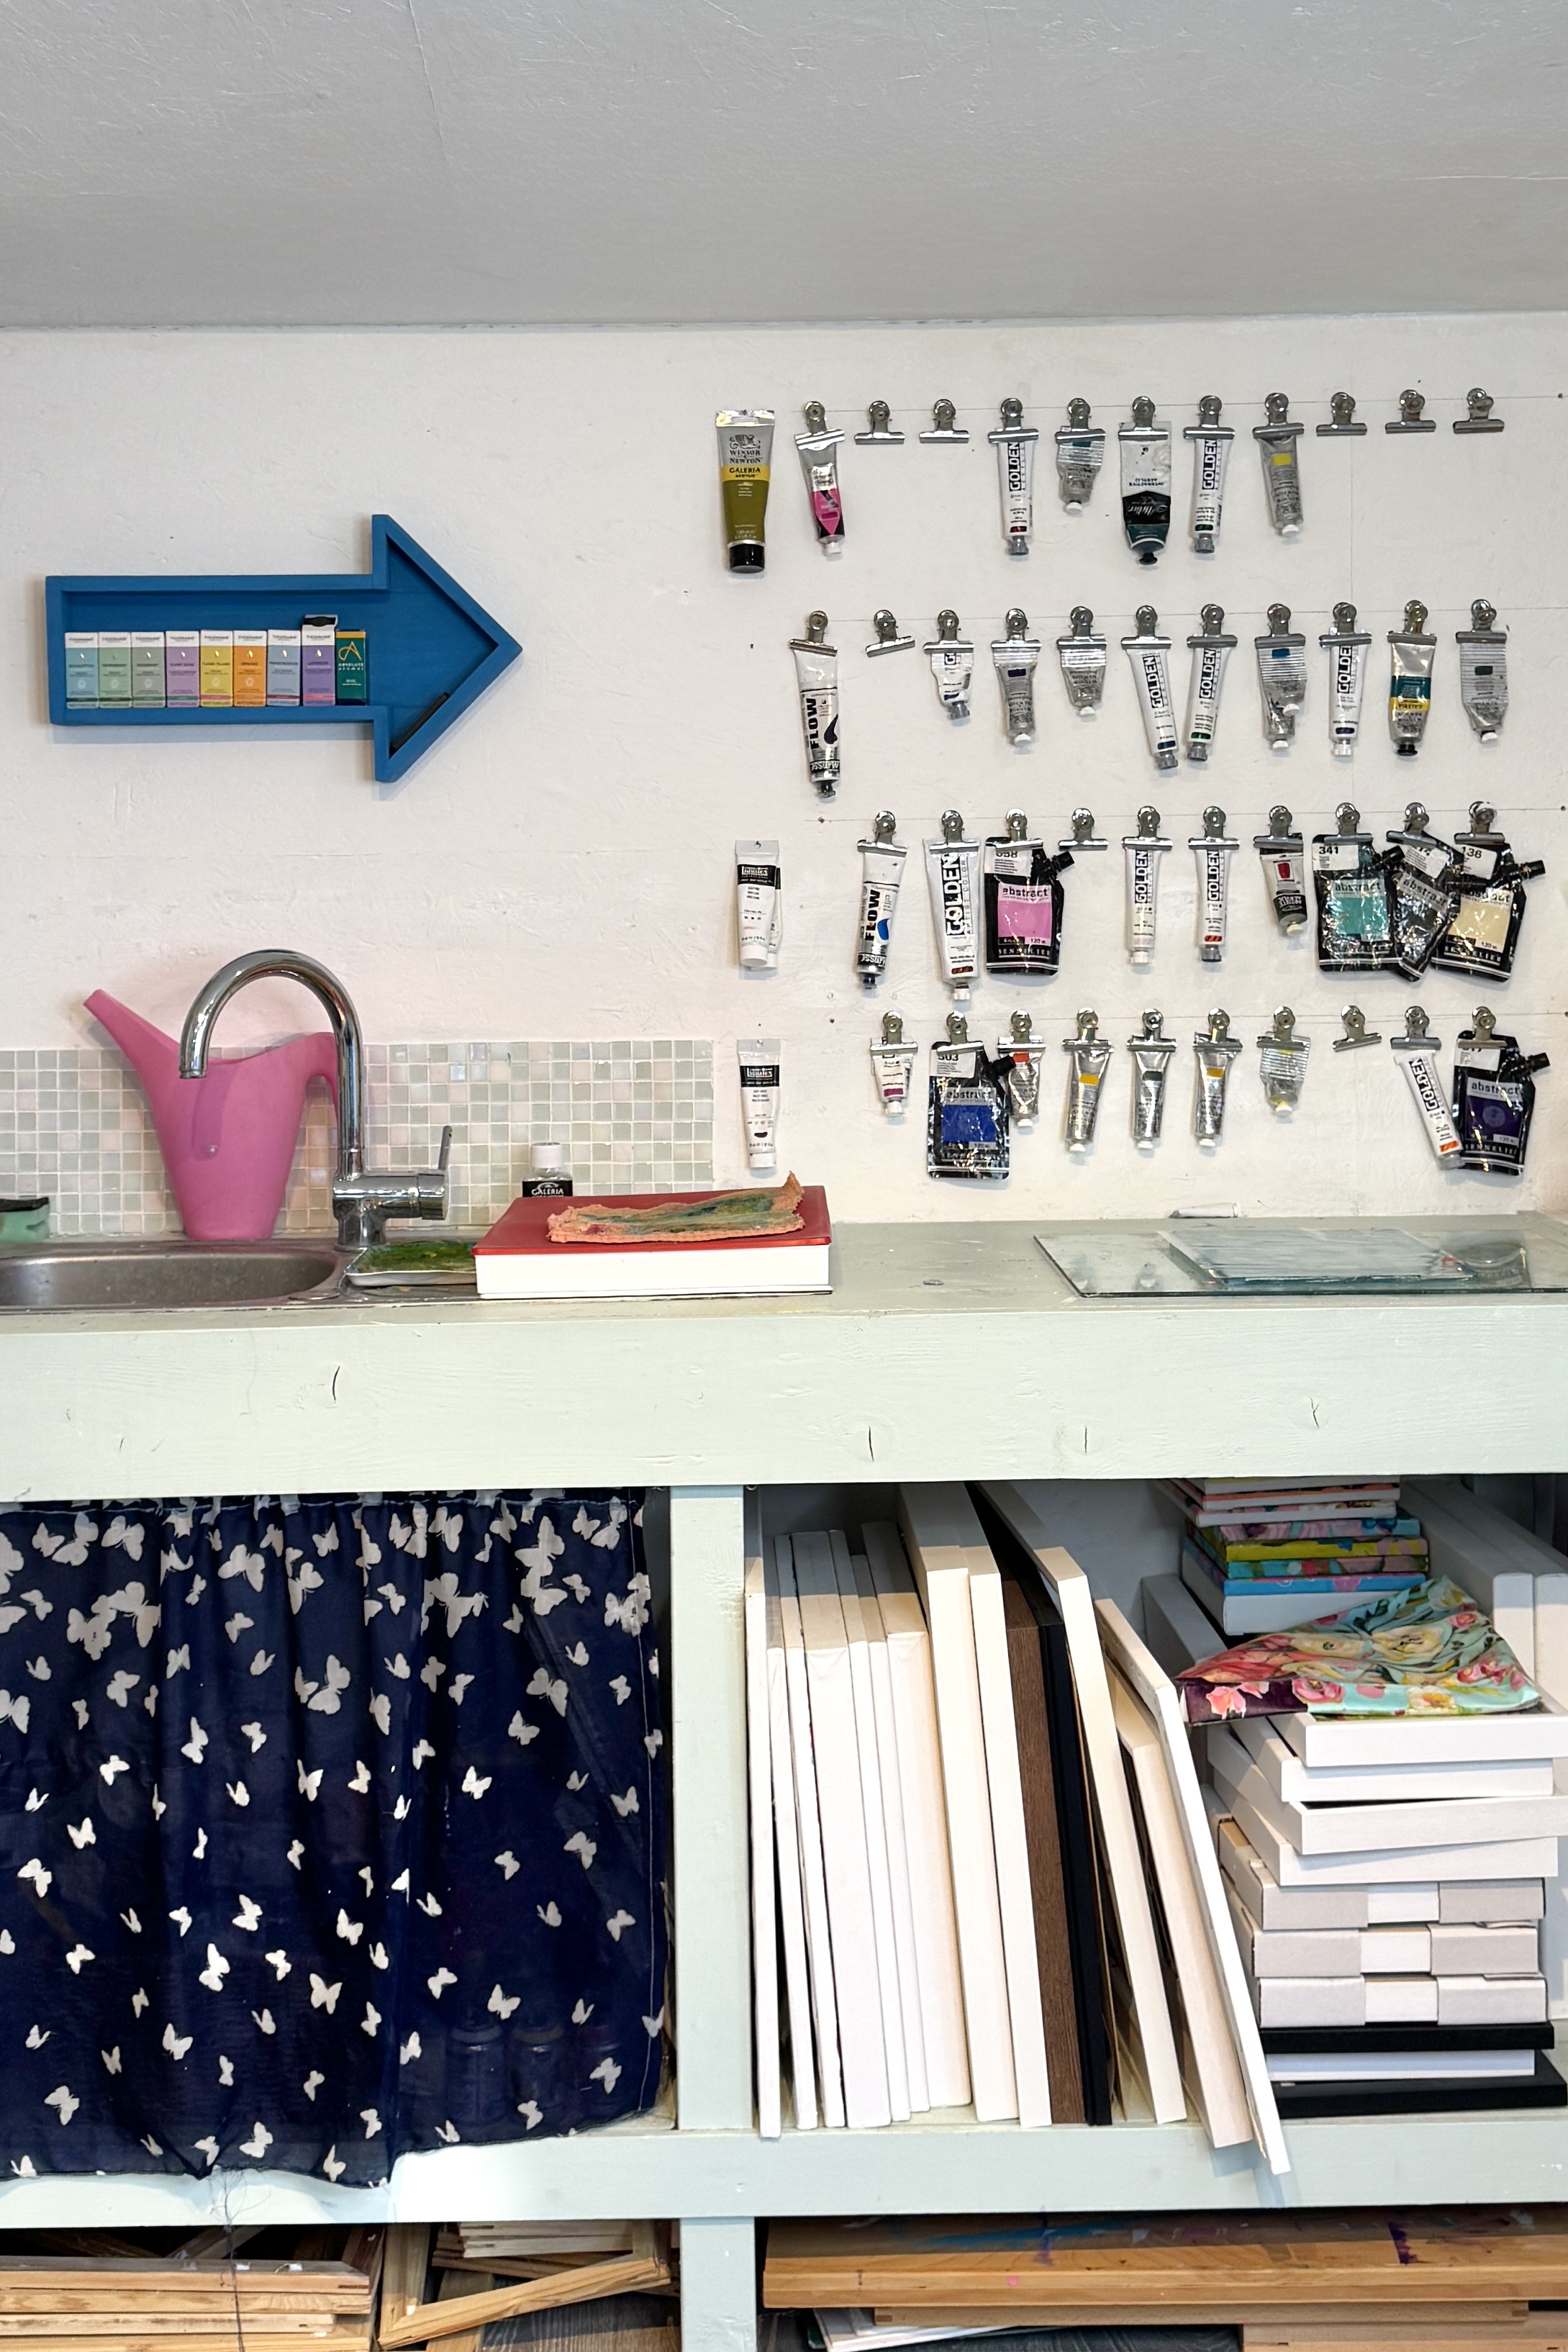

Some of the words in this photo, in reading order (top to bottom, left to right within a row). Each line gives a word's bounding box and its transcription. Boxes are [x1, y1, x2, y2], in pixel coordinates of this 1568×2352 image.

[1143, 656, 1164, 707] GOLDEN
[1200, 649, 1216, 698] GOLDEN
[1338, 646, 1351, 692] GOLDE
[806, 697, 819, 750] FLOW
[1002, 886, 1048, 898] abstract
[1136, 851, 1147, 903] GOLDEN
[1208, 851, 1219, 900] GOLDEN
[865, 889, 881, 941] FLOW
